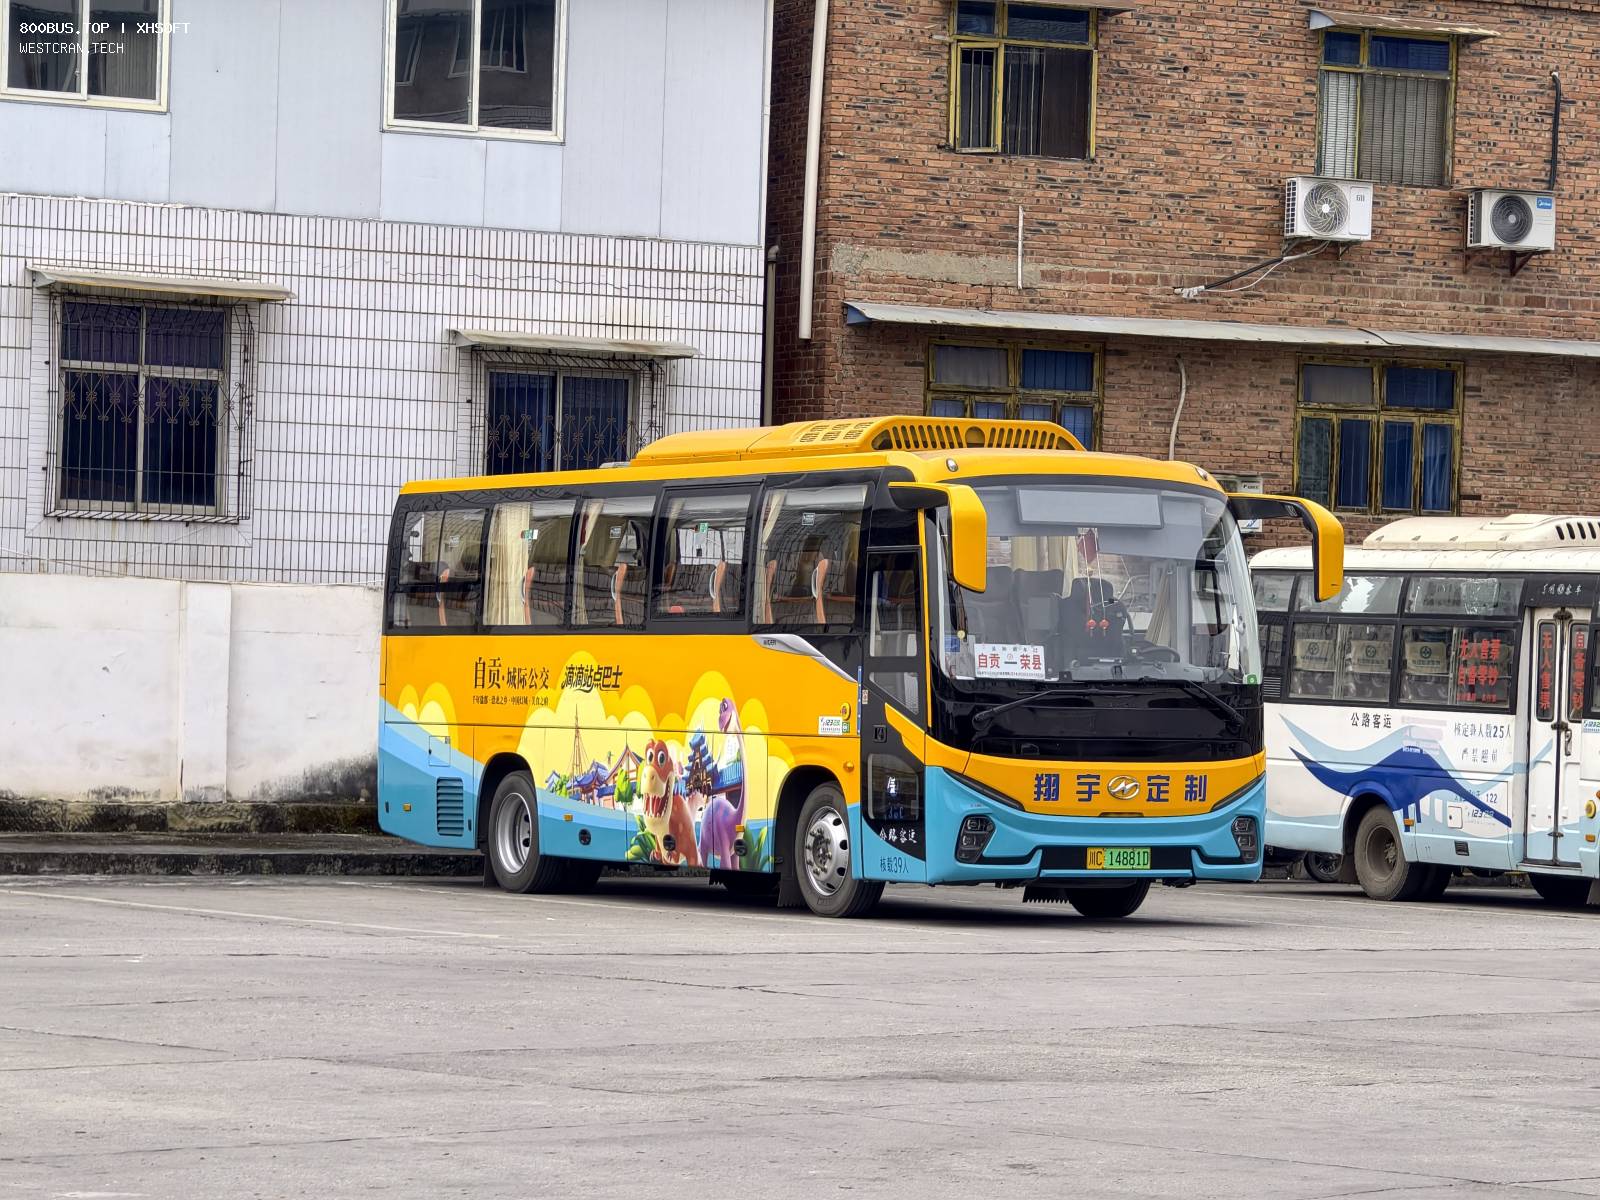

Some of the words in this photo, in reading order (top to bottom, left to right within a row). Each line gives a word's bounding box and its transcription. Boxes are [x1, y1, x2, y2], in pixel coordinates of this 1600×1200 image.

[1458, 639, 1501, 660] 无人售票
[561, 664, 623, 690] 滴滴站点巴士
[1540, 631, 1553, 710] 无人售票
[1350, 712, 1392, 729] 公路客运
[879, 827, 918, 844] 公路客运
[879, 856, 910, 874] 核载39人
